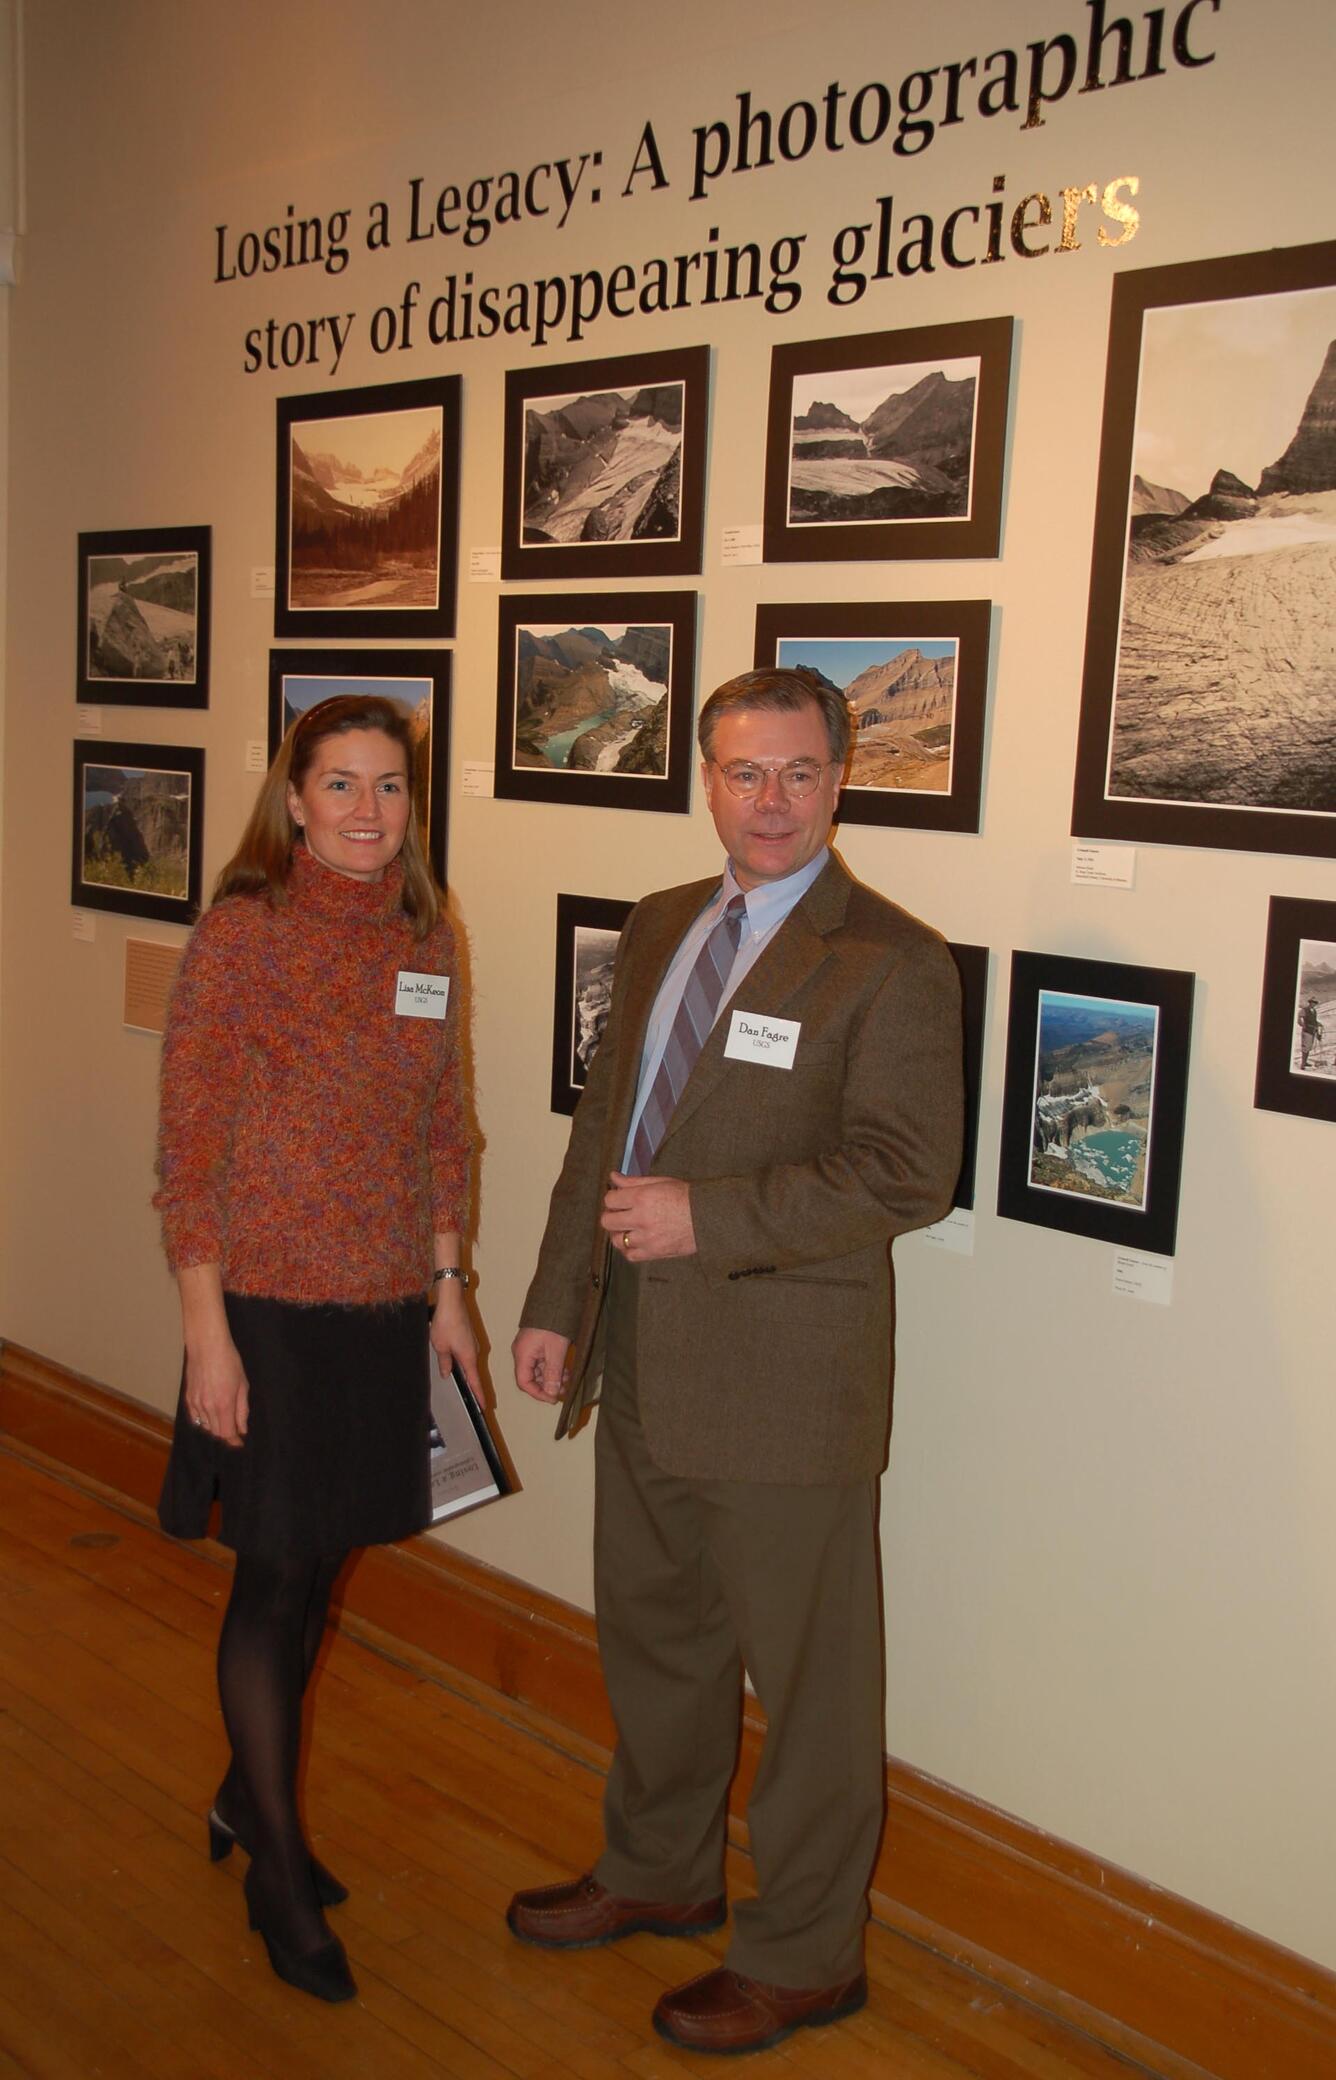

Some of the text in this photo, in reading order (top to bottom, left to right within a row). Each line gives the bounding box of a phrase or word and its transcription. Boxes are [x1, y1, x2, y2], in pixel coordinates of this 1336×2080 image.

[214, 0, 1222, 283] Losing a Legacy: A photographic
[243, 174, 1143, 376] story of disappearing glaciers
[739, 1022, 790, 1042] Dan Fagre
[752, 1039, 771, 1049] USGS
